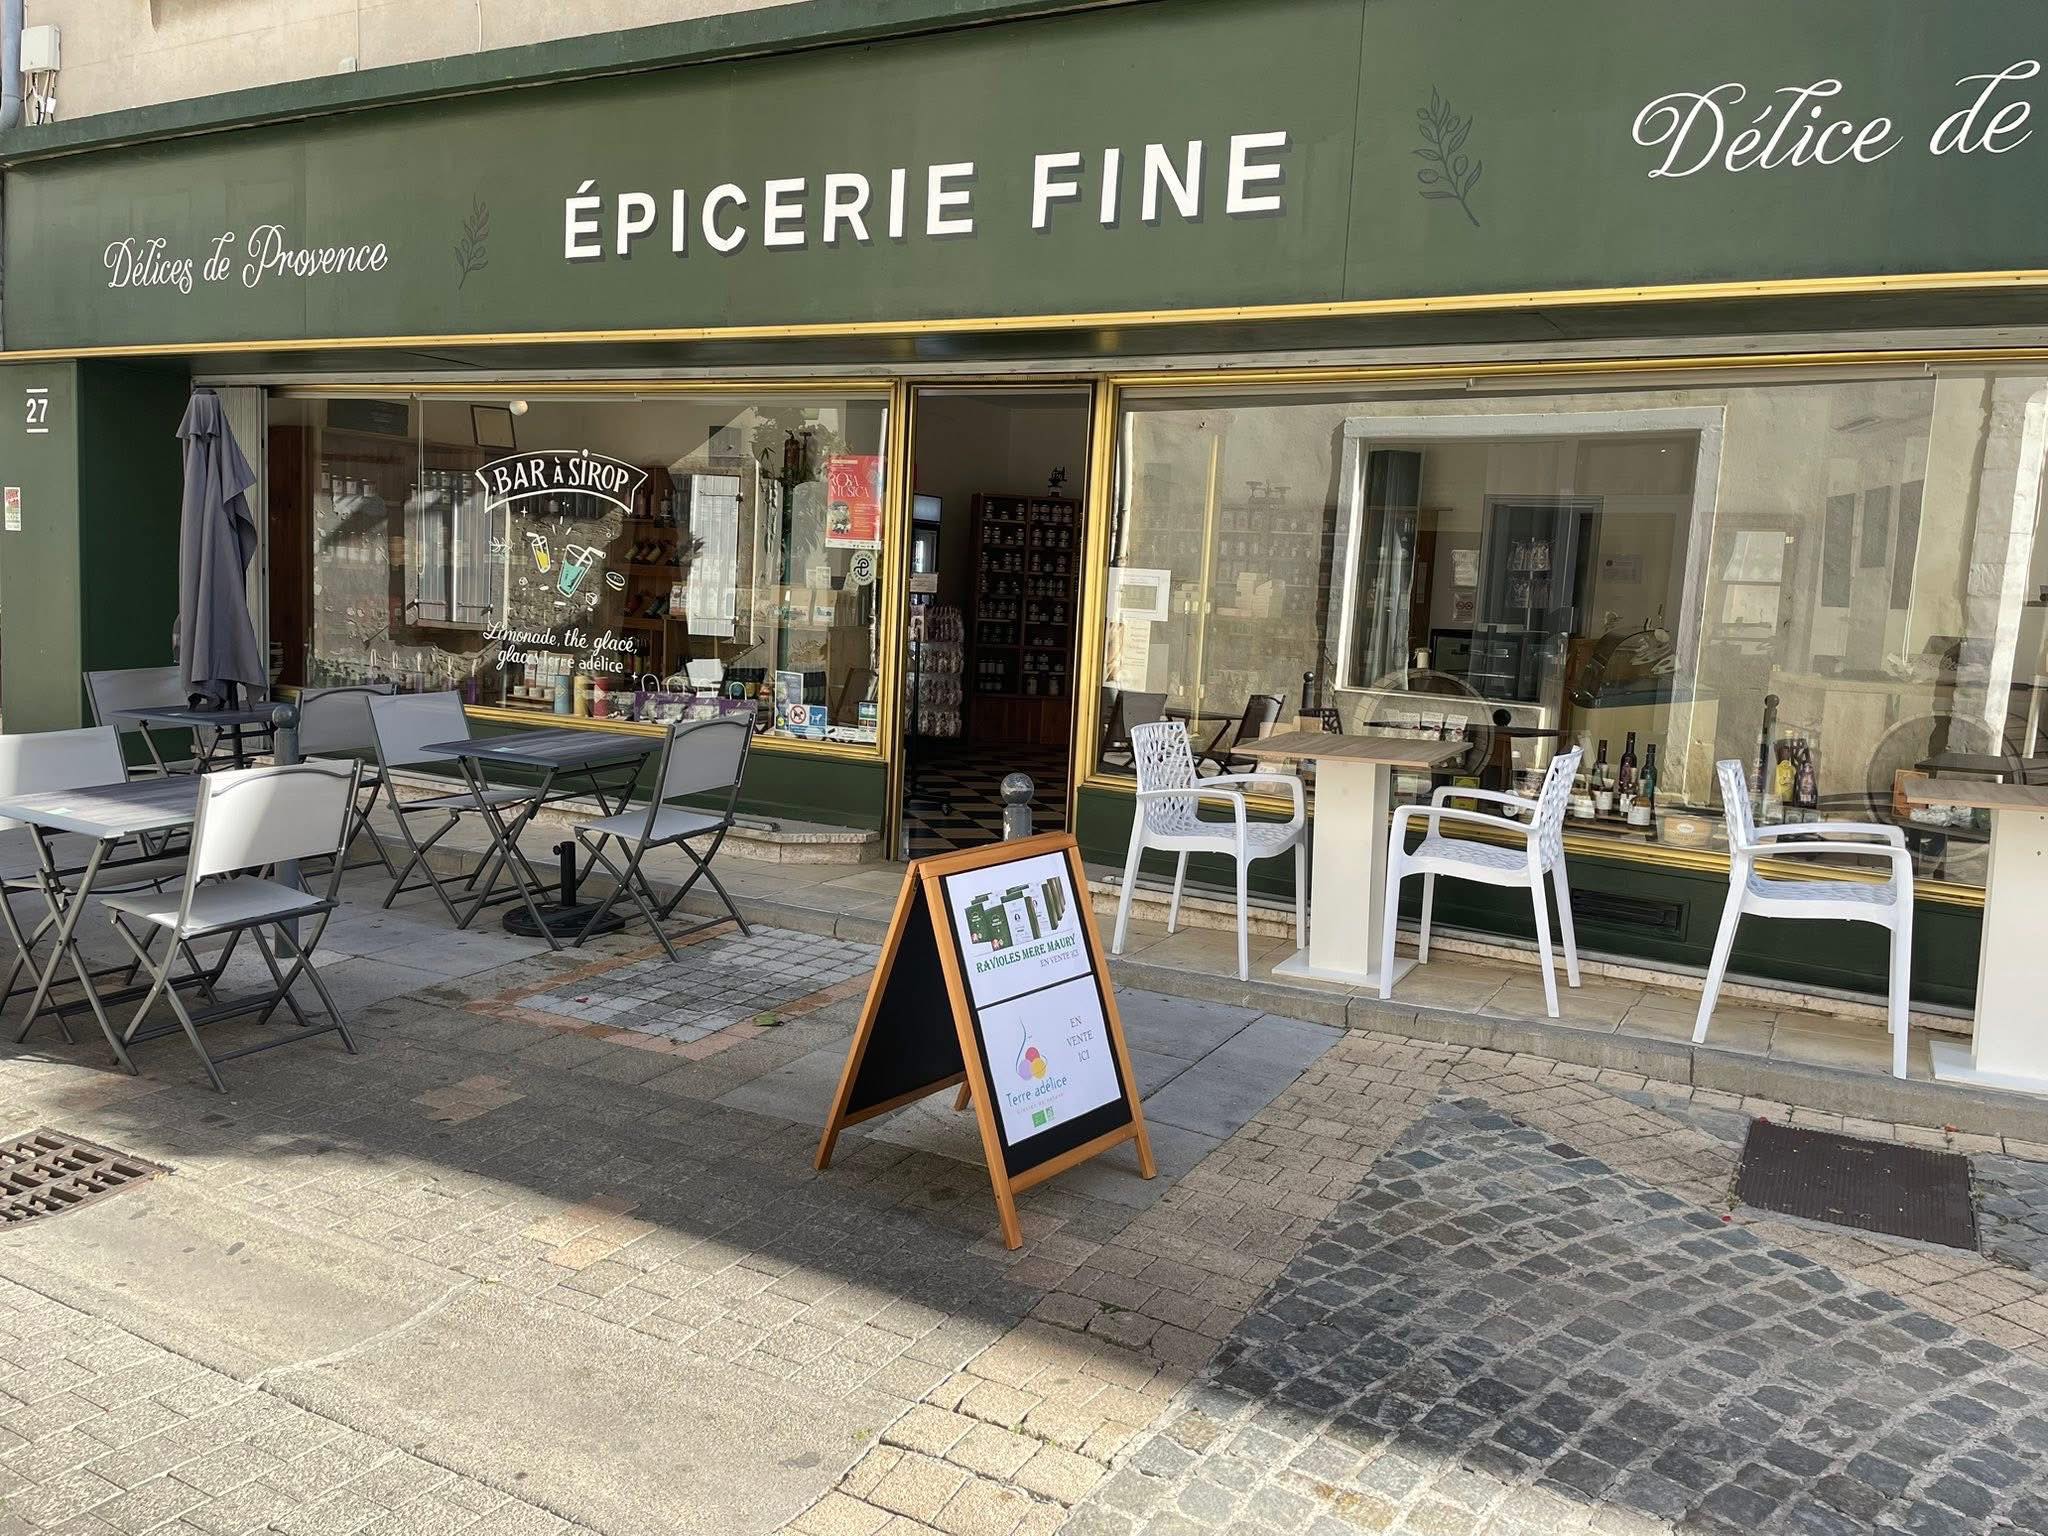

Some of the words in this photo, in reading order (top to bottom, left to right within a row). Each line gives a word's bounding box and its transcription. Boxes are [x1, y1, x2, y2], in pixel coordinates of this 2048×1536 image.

[1631, 78, 1904, 179] Délice
[1929, 59, 2041, 156] de
[563, 162, 978, 262] ÉPICERIE
[1031, 131, 1290, 233] FINE
[103, 237, 193, 295] Délices
[203, 231, 236, 282] de
[242, 224, 389, 288] Provence
[26, 398, 49, 423] 27
[493, 458, 549, 495] BAR
[568, 449, 630, 493] SIROP
[830, 486, 870, 498] MUSICA
[482, 620, 561, 647] Limonade,
[564, 627, 589, 649] thé
[593, 629, 638, 657] glacé,
[543, 650, 575, 669] Terre
[578, 655, 624, 674] adélice
[976, 951, 1021, 973] RAVIOLES
[1022, 943, 1046, 961] MERE
[1046, 934, 1076, 952] MAURY
[1040, 957, 1051, 968] EN
[1051, 951, 1071, 965] VENTE
[1070, 950, 1080, 958] ICI
[1070, 1016, 1082, 1028] EN
[1066, 1029, 1095, 1047] VENTE
[1078, 1049, 1090, 1063] ICI
[1006, 1090, 1032, 1107] Terre
[1034, 1076, 1067, 1097] adélice
